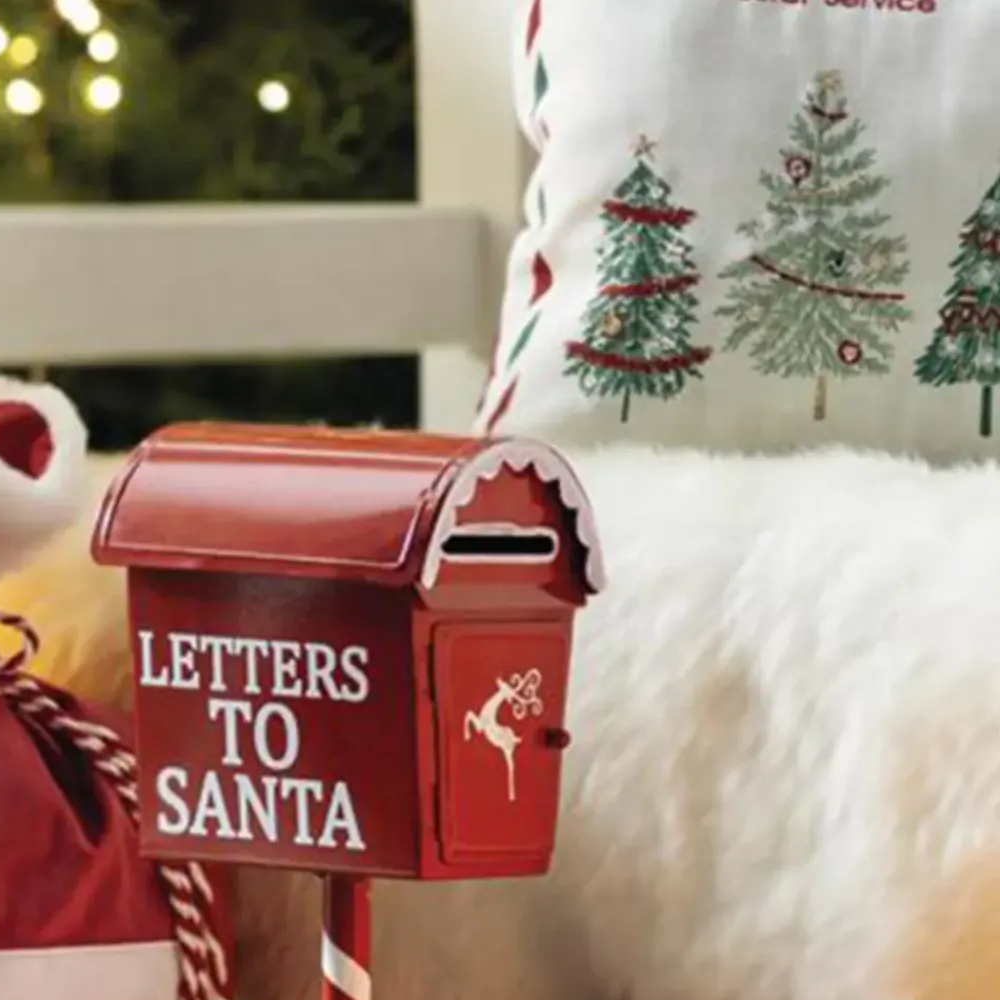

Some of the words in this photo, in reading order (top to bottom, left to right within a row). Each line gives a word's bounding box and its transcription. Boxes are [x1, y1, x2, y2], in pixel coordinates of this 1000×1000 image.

[138, 630, 369, 702] LETTERS
[208, 698, 299, 770] TO
[156, 766, 366, 851] SANTA
